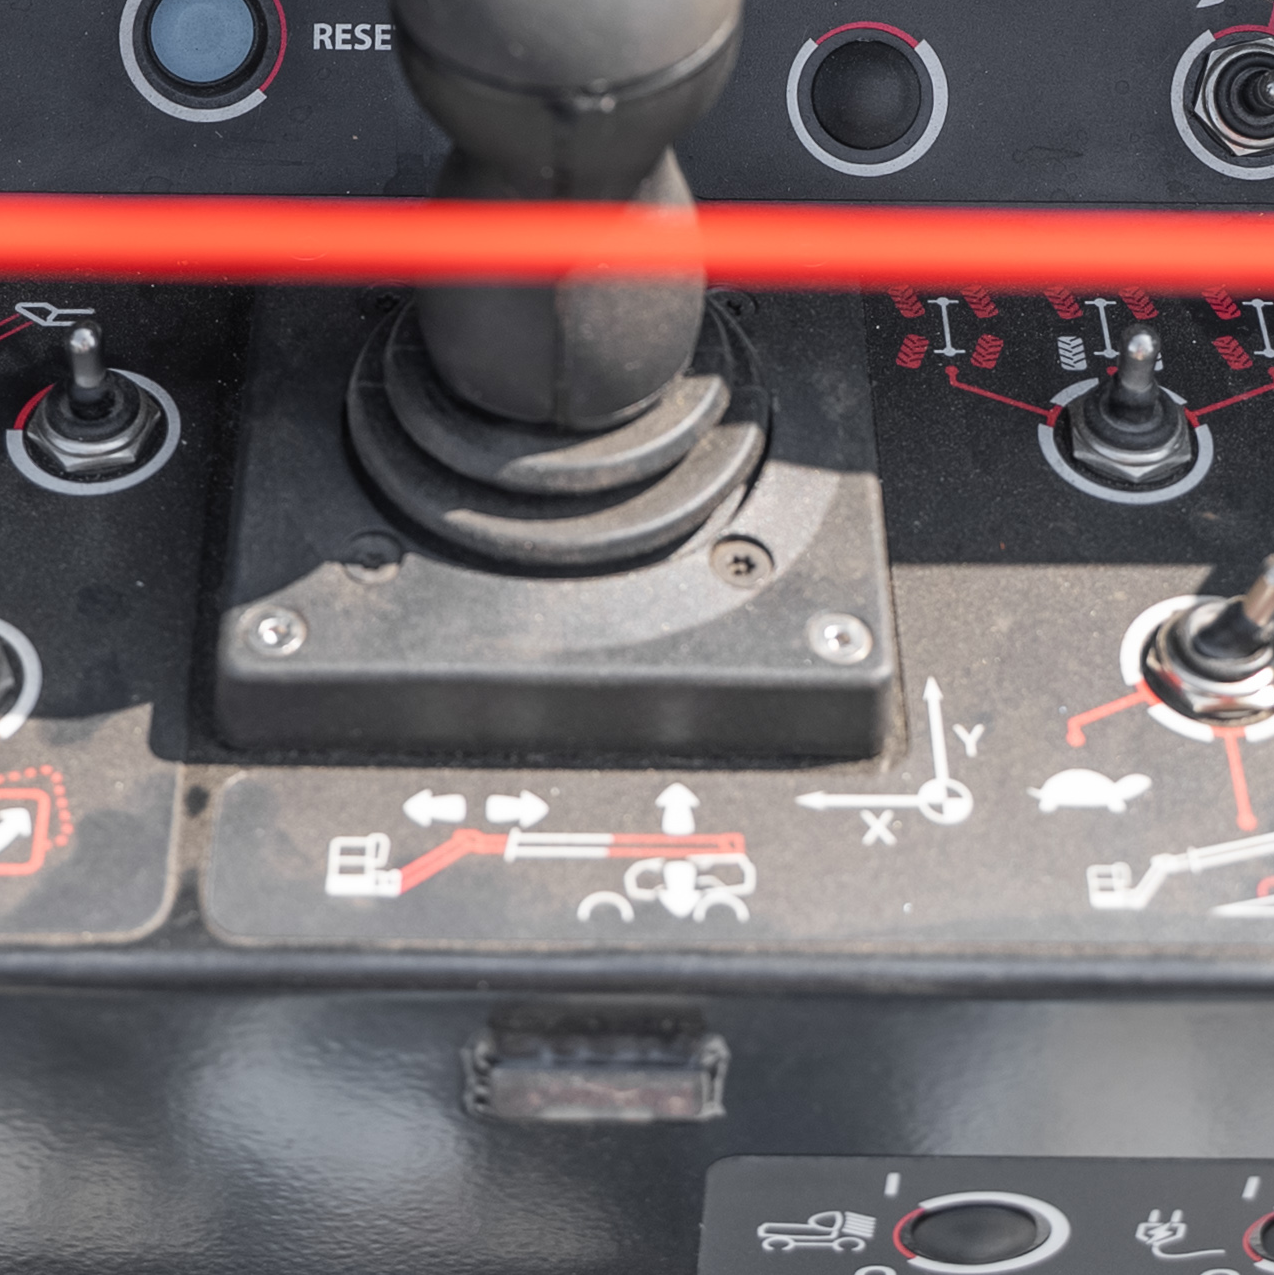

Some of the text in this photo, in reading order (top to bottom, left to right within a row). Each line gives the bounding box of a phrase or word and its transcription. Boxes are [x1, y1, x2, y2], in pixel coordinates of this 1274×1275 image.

[313, 22, 396, 51] RESE
[952, 723, 985, 758] Y
[860, 809, 897, 846] X
